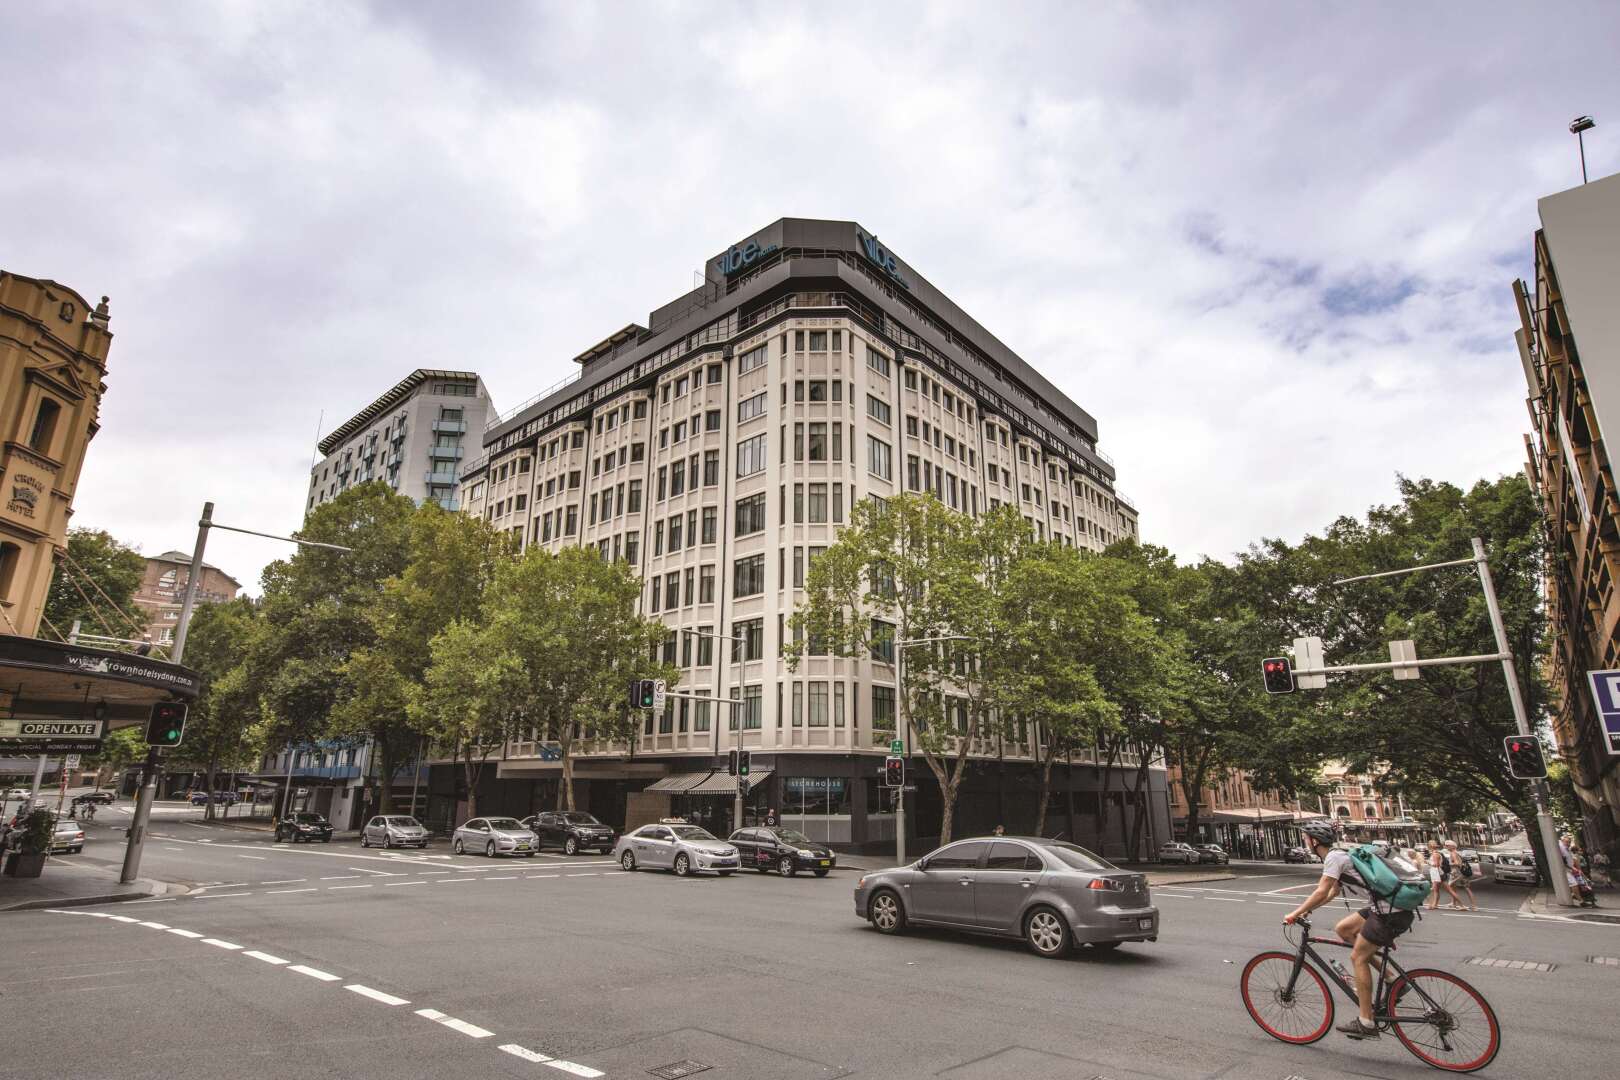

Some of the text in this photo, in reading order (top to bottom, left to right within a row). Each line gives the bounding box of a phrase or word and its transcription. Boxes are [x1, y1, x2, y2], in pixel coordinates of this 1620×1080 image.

[68, 655, 193, 686] wrownhotelsydney.com.au
[24, 724, 60, 734] OPEN
[62, 724, 93, 734] LATE
